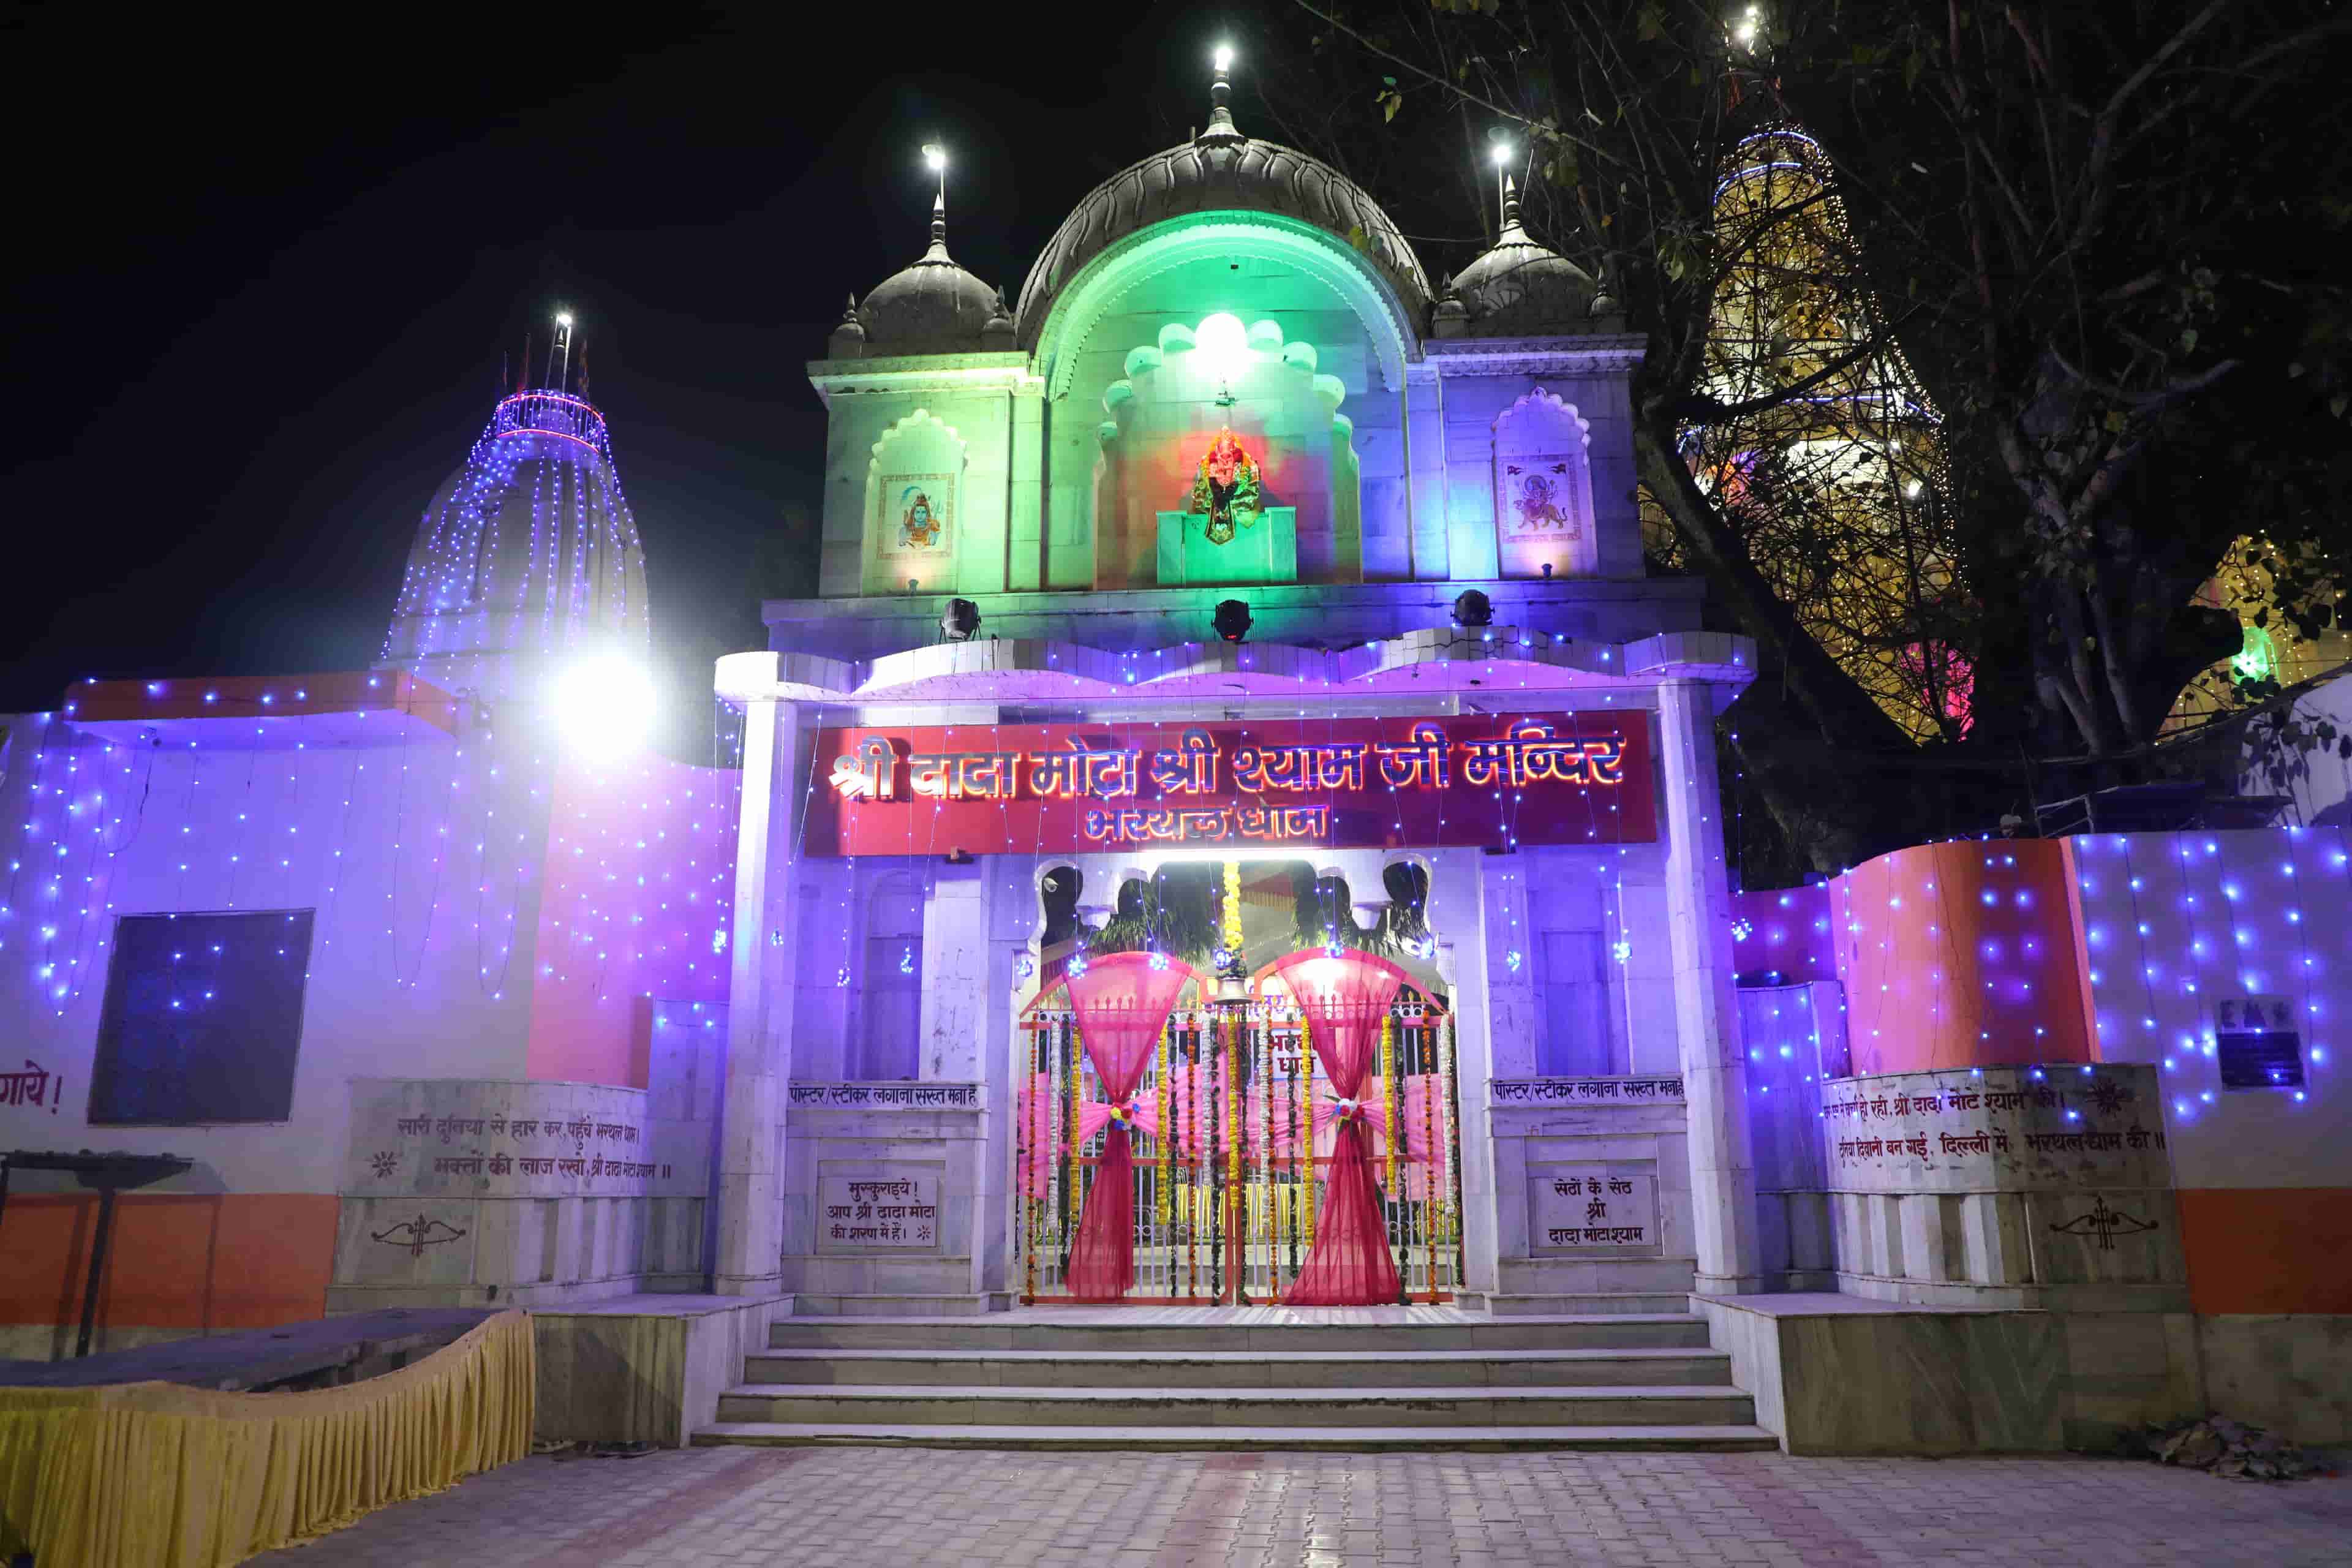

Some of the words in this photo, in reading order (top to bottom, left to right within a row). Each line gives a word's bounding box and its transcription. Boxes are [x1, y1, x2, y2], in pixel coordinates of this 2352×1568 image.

[829, 734, 898, 798] श्री
[909, 751, 1021, 799] दादा
[1028, 731, 1142, 798] मोटा
[1150, 727, 1221, 794] श्री
[1233, 744, 1369, 793] श्याम
[1374, 720, 1454, 788] जी
[1461, 718, 1627, 787] मन्दिर
[1237, 804, 1330, 838] धाम
[873, 1087, 913, 1105] लगाना
[916, 1087, 946, 1106] सख्त
[947, 1086, 967, 1106] मना
[968, 1084, 978, 1106] है
[1578, 1080, 1619, 1099] लगाना
[1623, 1080, 1657, 1097] सख्त
[1894, 1092, 1912, 1116] श्री
[1912, 1096, 1943, 1116] दादा
[1985, 1091, 2026, 1114] श्याम
[491, 1112, 507, 1136] से
[511, 1120, 539, 1143] हार
[1885, 1139, 1904, 1156] बन
[1940, 1129, 1991, 1158] दिल्ली
[1993, 1126, 2010, 1154] में
[488, 1152, 514, 1176] की
[519, 1156, 556, 1177] लाज
[590, 1152, 603, 1177] श्री
[605, 1159, 622, 1177] दादा
[1554, 1177, 1581, 1197] सेठों
[1587, 1177, 1602, 1196] के
[1608, 1177, 1632, 1196] सेठ
[827, 1205, 851, 1219] आप
[856, 1201, 872, 1221] श्री
[877, 1205, 905, 1220] दादा
[908, 1199, 935, 1219] मोटा
[1587, 1198, 1606, 1219] श्री
[831, 1223, 846, 1240] की
[849, 1227, 877, 1242] शरण
[1548, 1227, 1580, 1245] दादा
[1583, 1222, 1610, 1243] मोटा
[1610, 1226, 1644, 1244] श्याम
